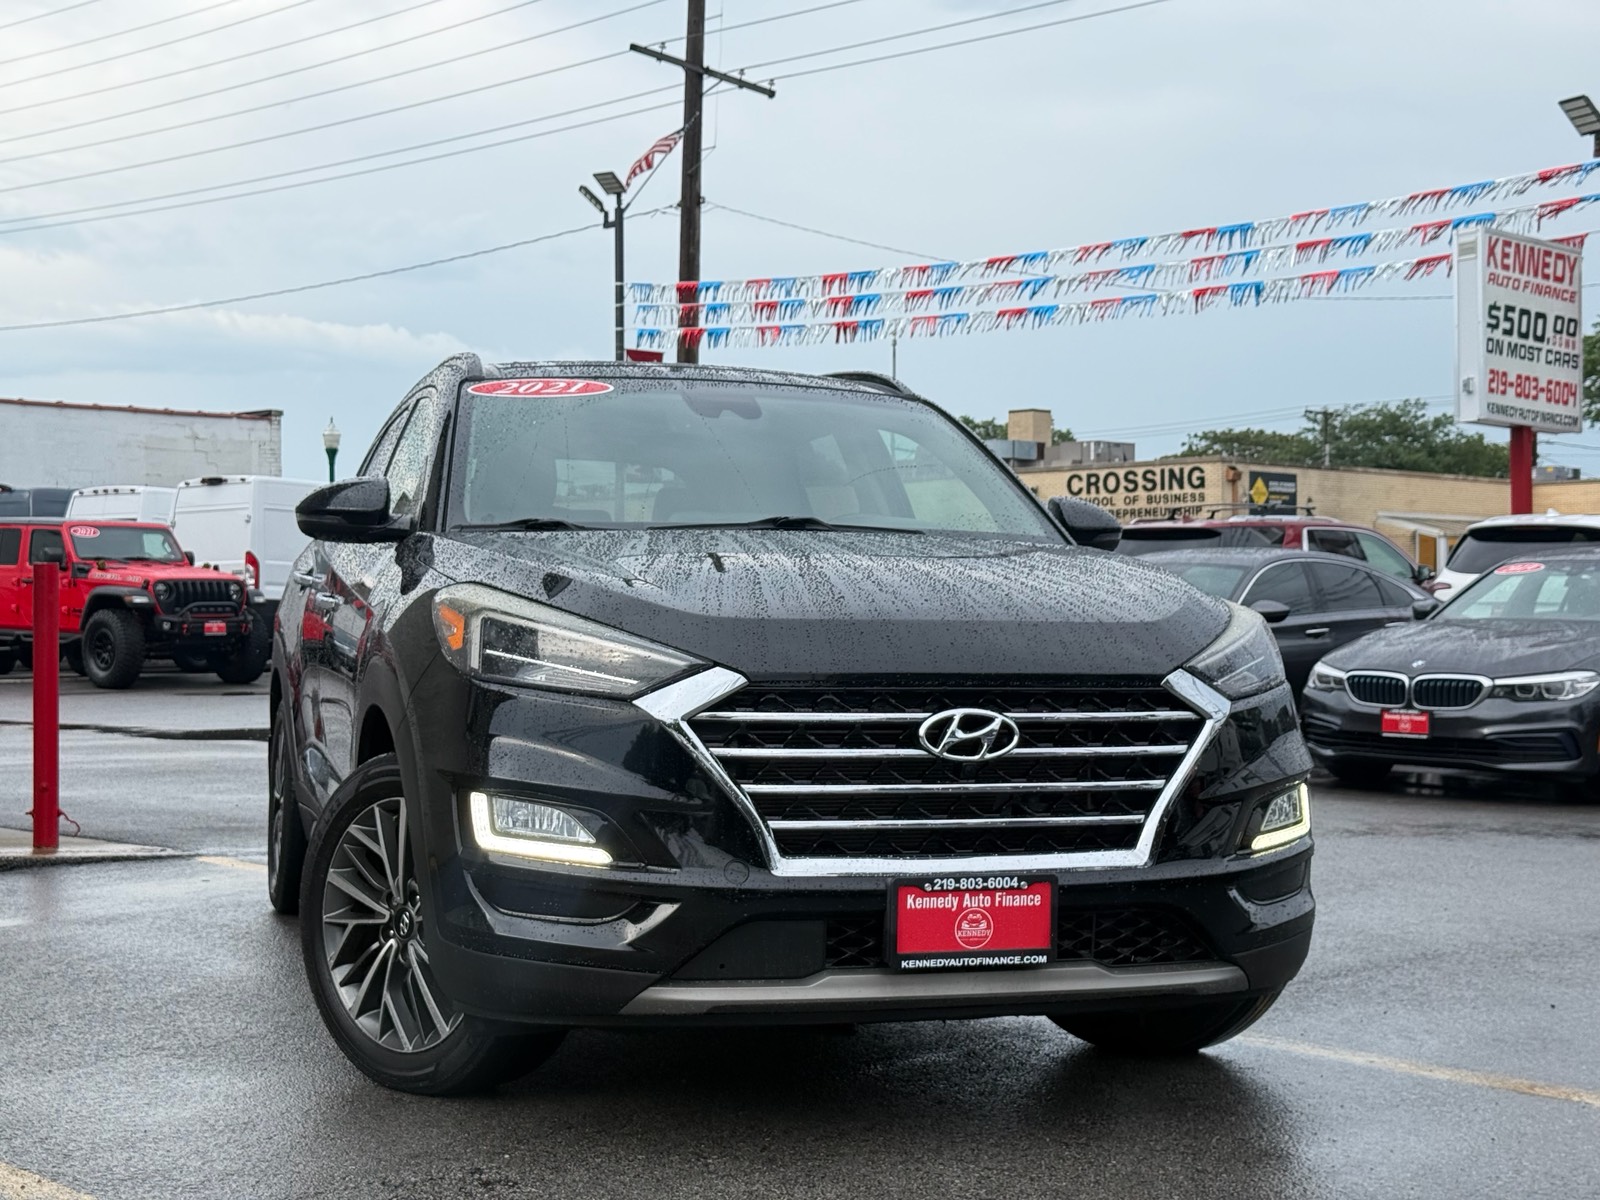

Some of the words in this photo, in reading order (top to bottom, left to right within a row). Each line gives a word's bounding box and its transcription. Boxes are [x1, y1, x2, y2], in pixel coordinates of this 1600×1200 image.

[1487, 235, 1578, 286] KENNEDY
[1487, 272, 1521, 291] AUTO
[1522, 280, 1577, 303] FINANCE
[1486, 338, 1504, 356] ON
[1506, 341, 1542, 363] MOST
[1545, 349, 1579, 369] CARS
[495, 381, 587, 394] 2021
[1488, 368, 1577, 407] 219-803-6004
[1487, 402, 1579, 426] KENNEDYAUTOFINANCE.COM
[1066, 466, 1206, 496] CROSSING
[1123, 495, 1140, 506] OF
[1146, 492, 1205, 505] BUSINESS
[933, 877, 1018, 890] 219-803-6004
[906, 894, 959, 911] Kennedy
[963, 893, 991, 908] Auto
[995, 892, 1041, 907] Finance
[958, 929, 991, 937] KENNEDY
[901, 955, 1047, 968] KENNEDYAUTOFINANCE.COM
